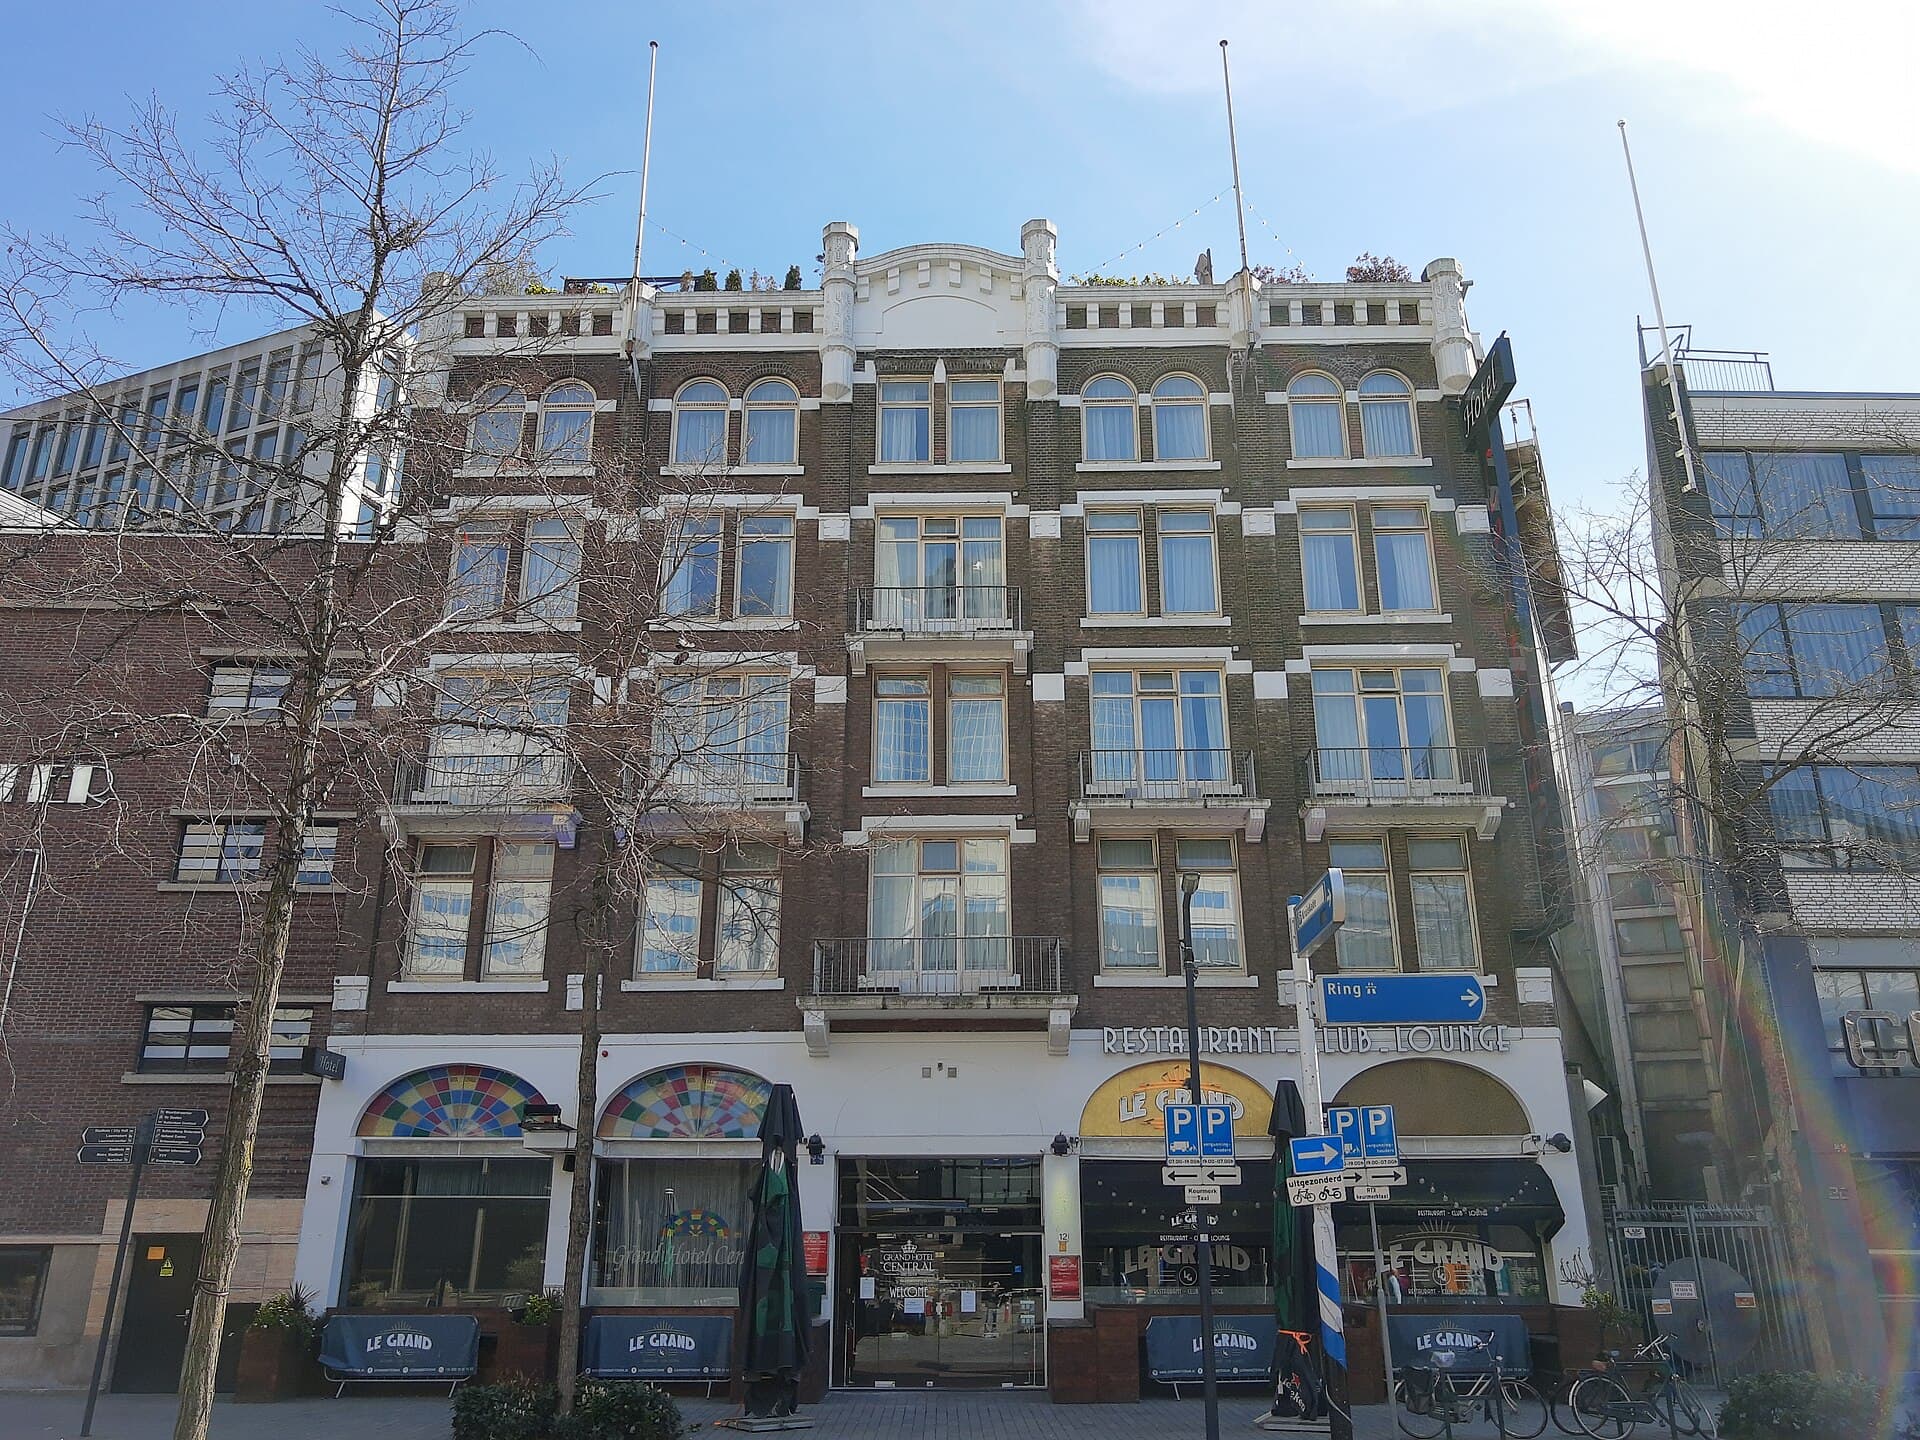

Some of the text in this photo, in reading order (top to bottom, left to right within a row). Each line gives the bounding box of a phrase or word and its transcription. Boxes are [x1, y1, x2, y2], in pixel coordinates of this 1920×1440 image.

[1463, 350, 1497, 438] Hotel
[1328, 982, 1361, 998] Ring
[1103, 1026, 1279, 1054] RESTARANT
[1323, 1026, 1372, 1053] LUB
[1396, 1025, 1511, 1053] LOUNGE
[1843, 1010, 1920, 1068] C
[320, 1055, 340, 1073] Hotel
[1119, 1091, 1148, 1122] LE
[1173, 1108, 1192, 1135] P
[1207, 1108, 1226, 1135] P
[1335, 1111, 1354, 1135] P
[1368, 1109, 1387, 1136] P
[1288, 1174, 1342, 1188] uitgezonderd
[612, 1242, 664, 1271] Grand
[671, 1242, 714, 1265] Hotel
[883, 1253, 935, 1261] GRAND HOTEL
[1414, 1239, 1504, 1272] GRAND
[883, 1261, 936, 1272] CENTRAL
[889, 1286, 929, 1298] WELCOME
[366, 1333, 433, 1352] LE GRAND
[629, 1333, 696, 1352] LE GRAND
[1213, 1333, 1258, 1351] GRAND
[1416, 1334, 1432, 1351] LE
